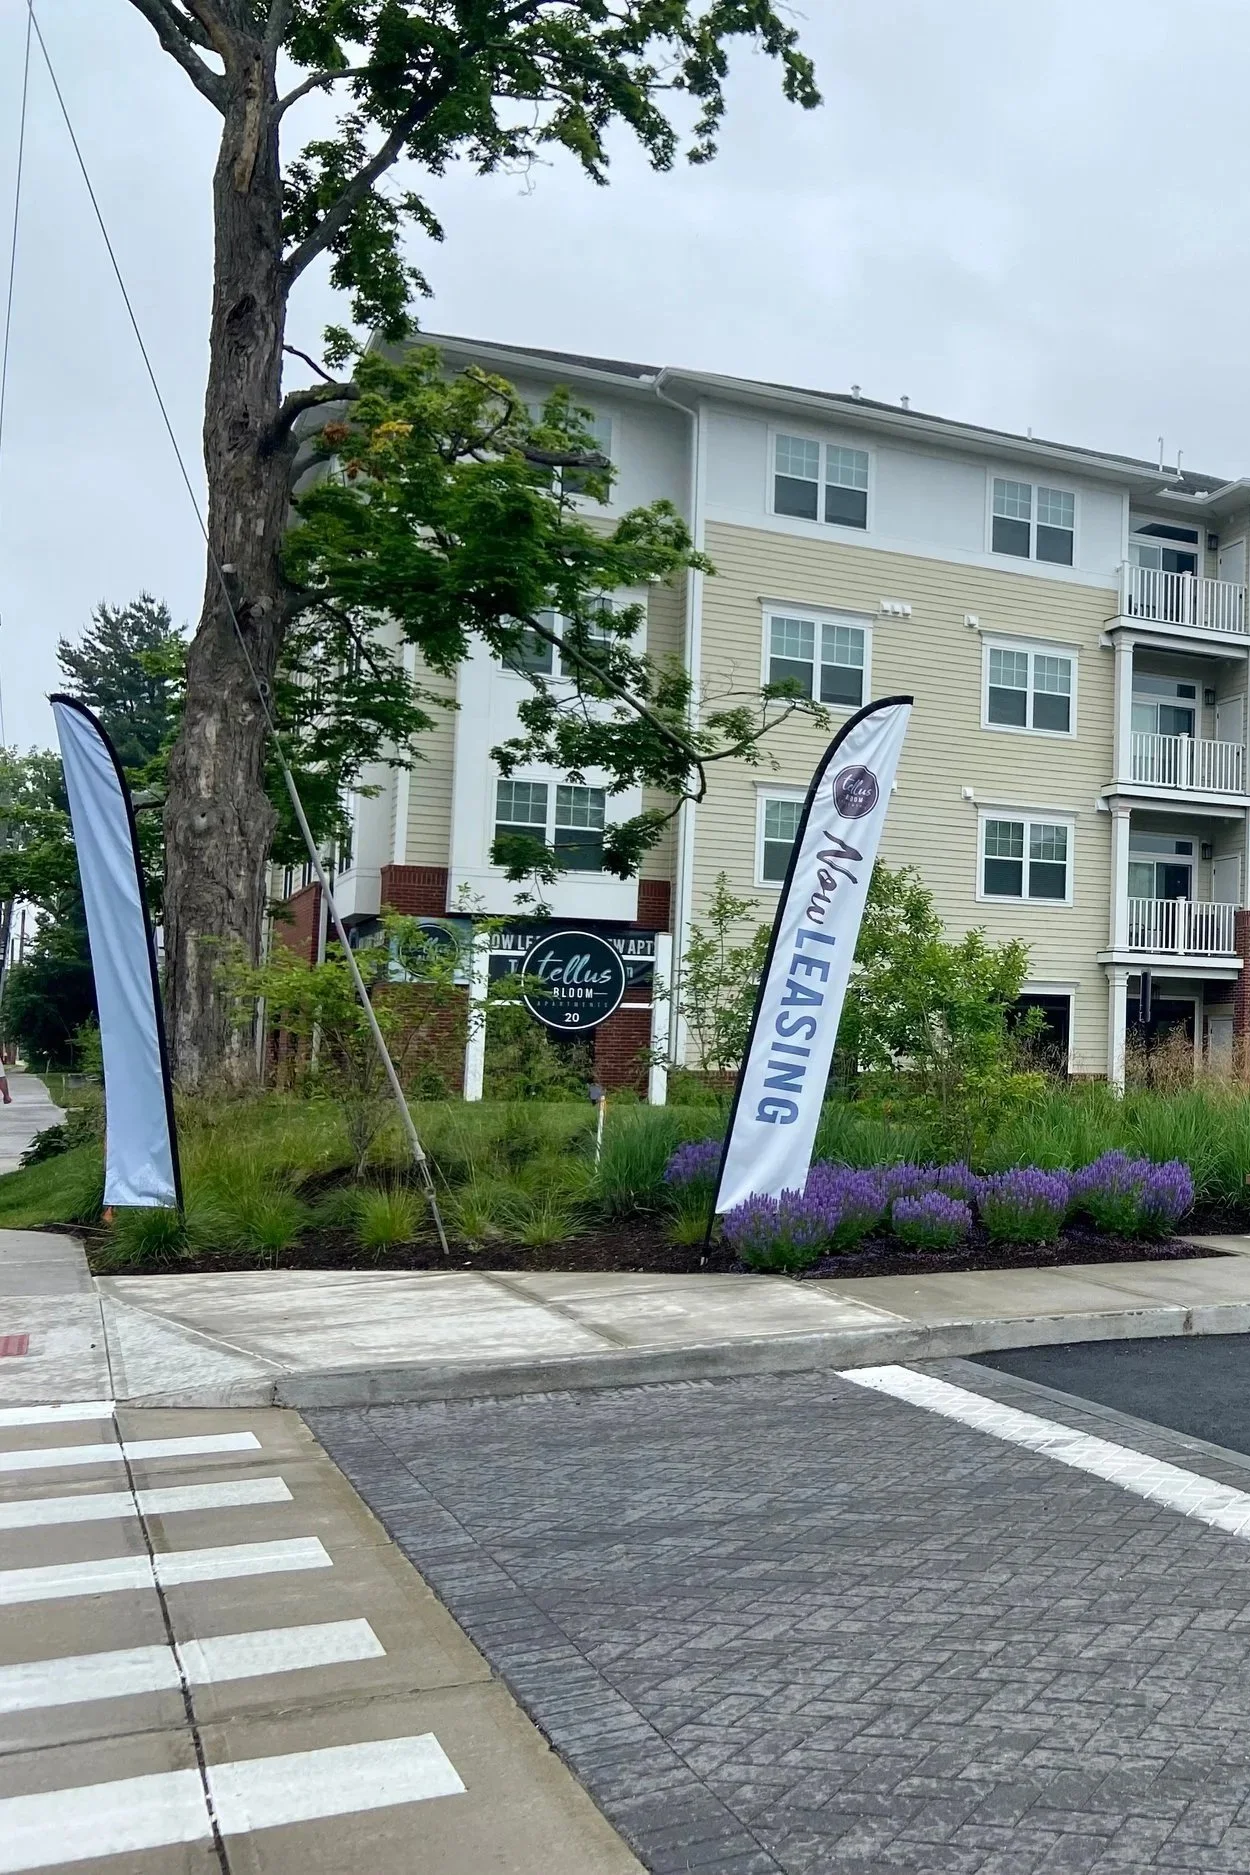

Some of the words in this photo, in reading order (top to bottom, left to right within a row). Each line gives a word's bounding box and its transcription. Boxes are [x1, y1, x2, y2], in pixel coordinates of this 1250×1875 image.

[806, 830, 864, 925] Now
[491, 933, 514, 950] OW
[627, 939, 656, 955] APT
[537, 950, 612, 985] tellus
[553, 987, 594, 999] BLOOM
[537, 1000, 609, 1009] APARTMENTS
[564, 1012, 580, 1023] 20
[755, 927, 836, 1125] LEASING
